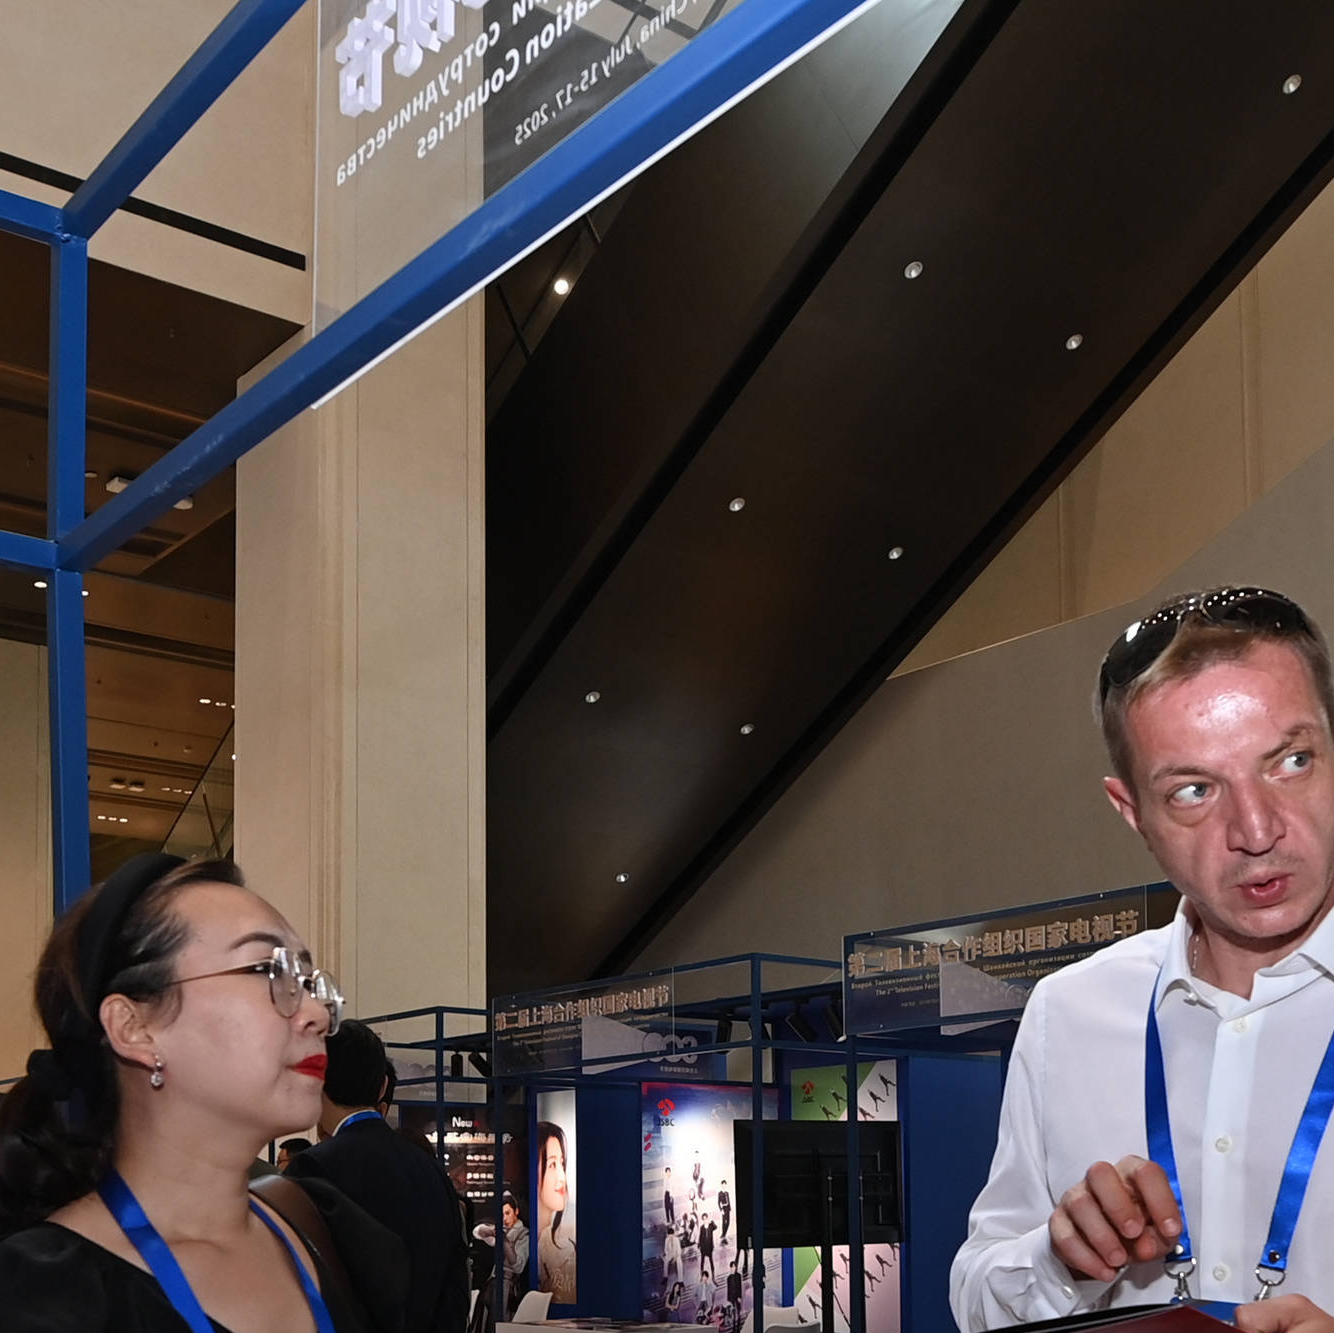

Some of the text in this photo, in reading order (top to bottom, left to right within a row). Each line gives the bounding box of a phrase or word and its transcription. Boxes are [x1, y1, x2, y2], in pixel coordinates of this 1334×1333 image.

[848, 910, 1139, 978] 第二届上海合作组织国家电视节
